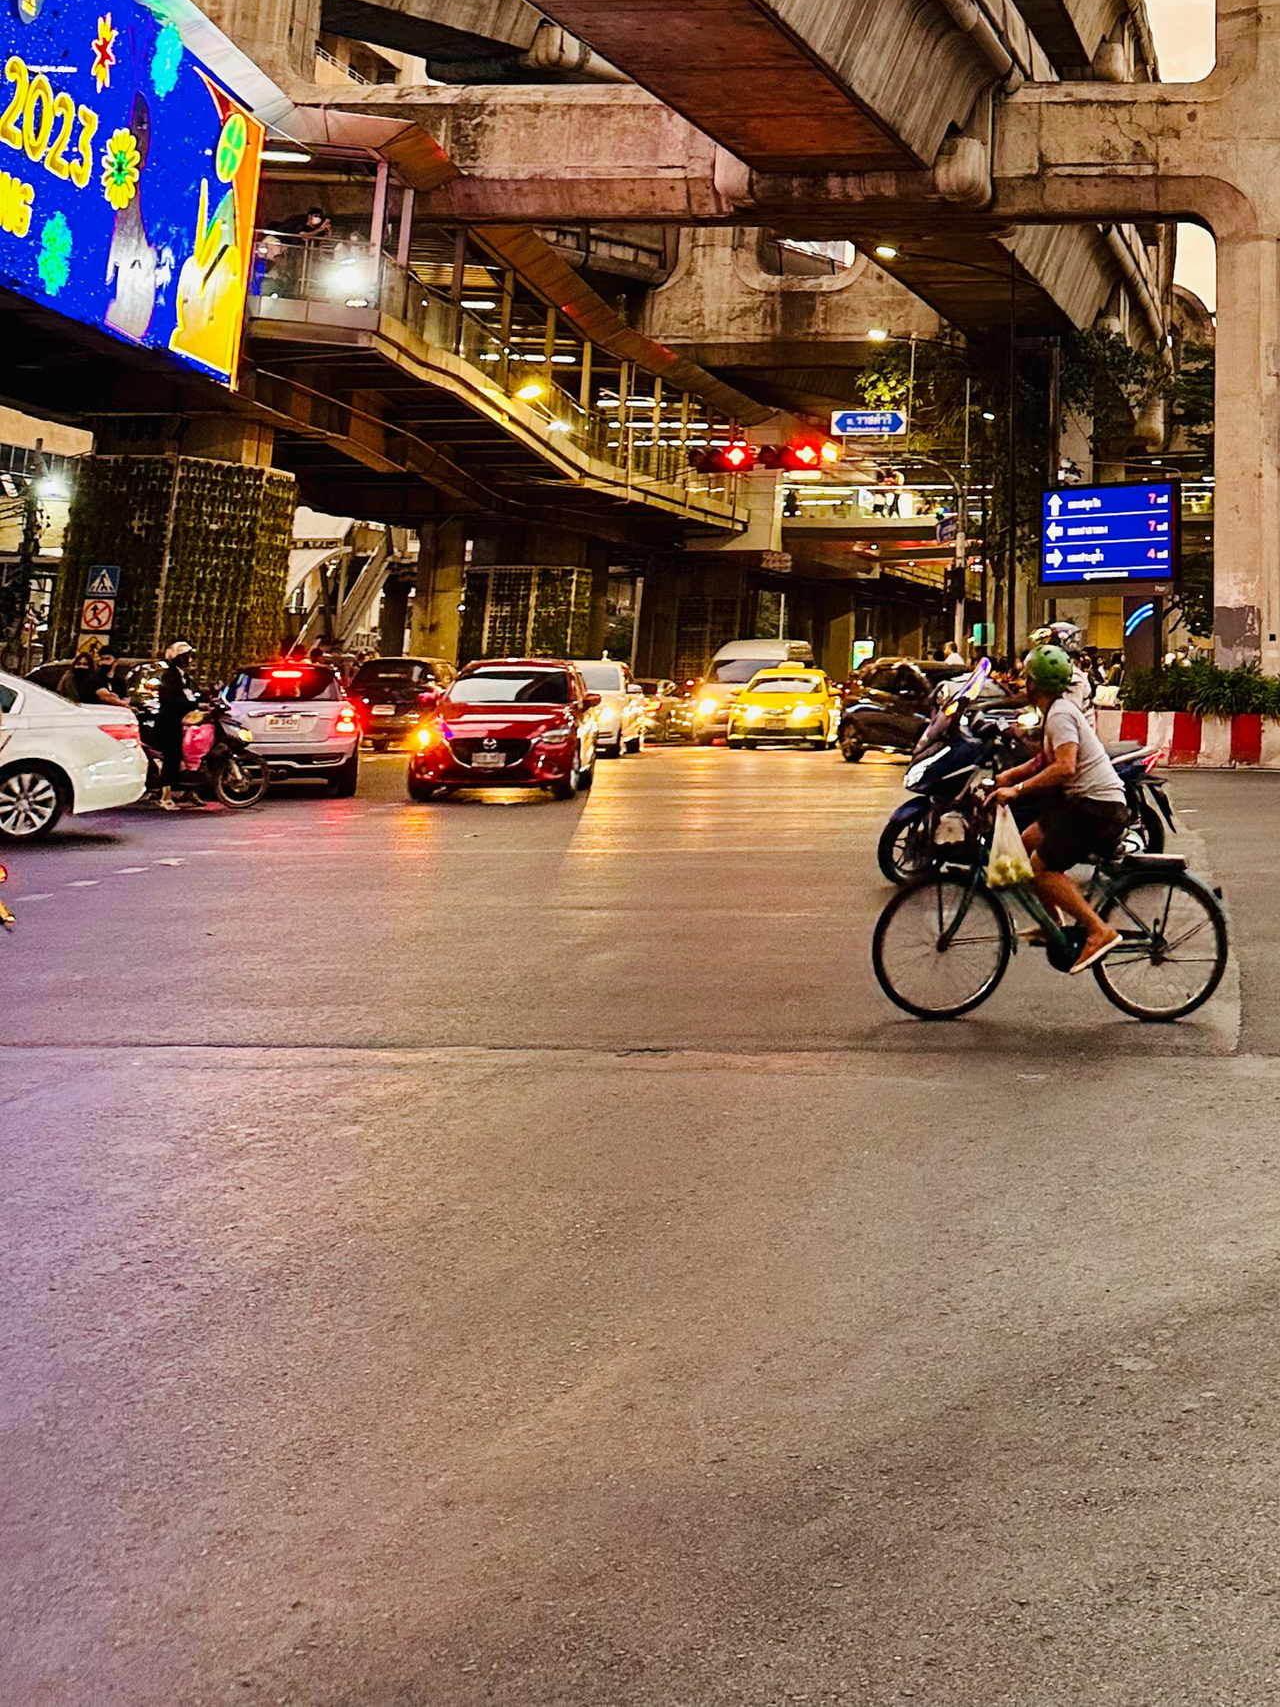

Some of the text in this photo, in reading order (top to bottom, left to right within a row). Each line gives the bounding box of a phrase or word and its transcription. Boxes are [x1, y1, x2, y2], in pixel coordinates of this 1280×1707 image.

[0, 55, 99, 188] 2023
[1147, 492, 1157, 505] 7
[1147, 519, 1157, 532] 7
[1146, 547, 1156, 559] 4
